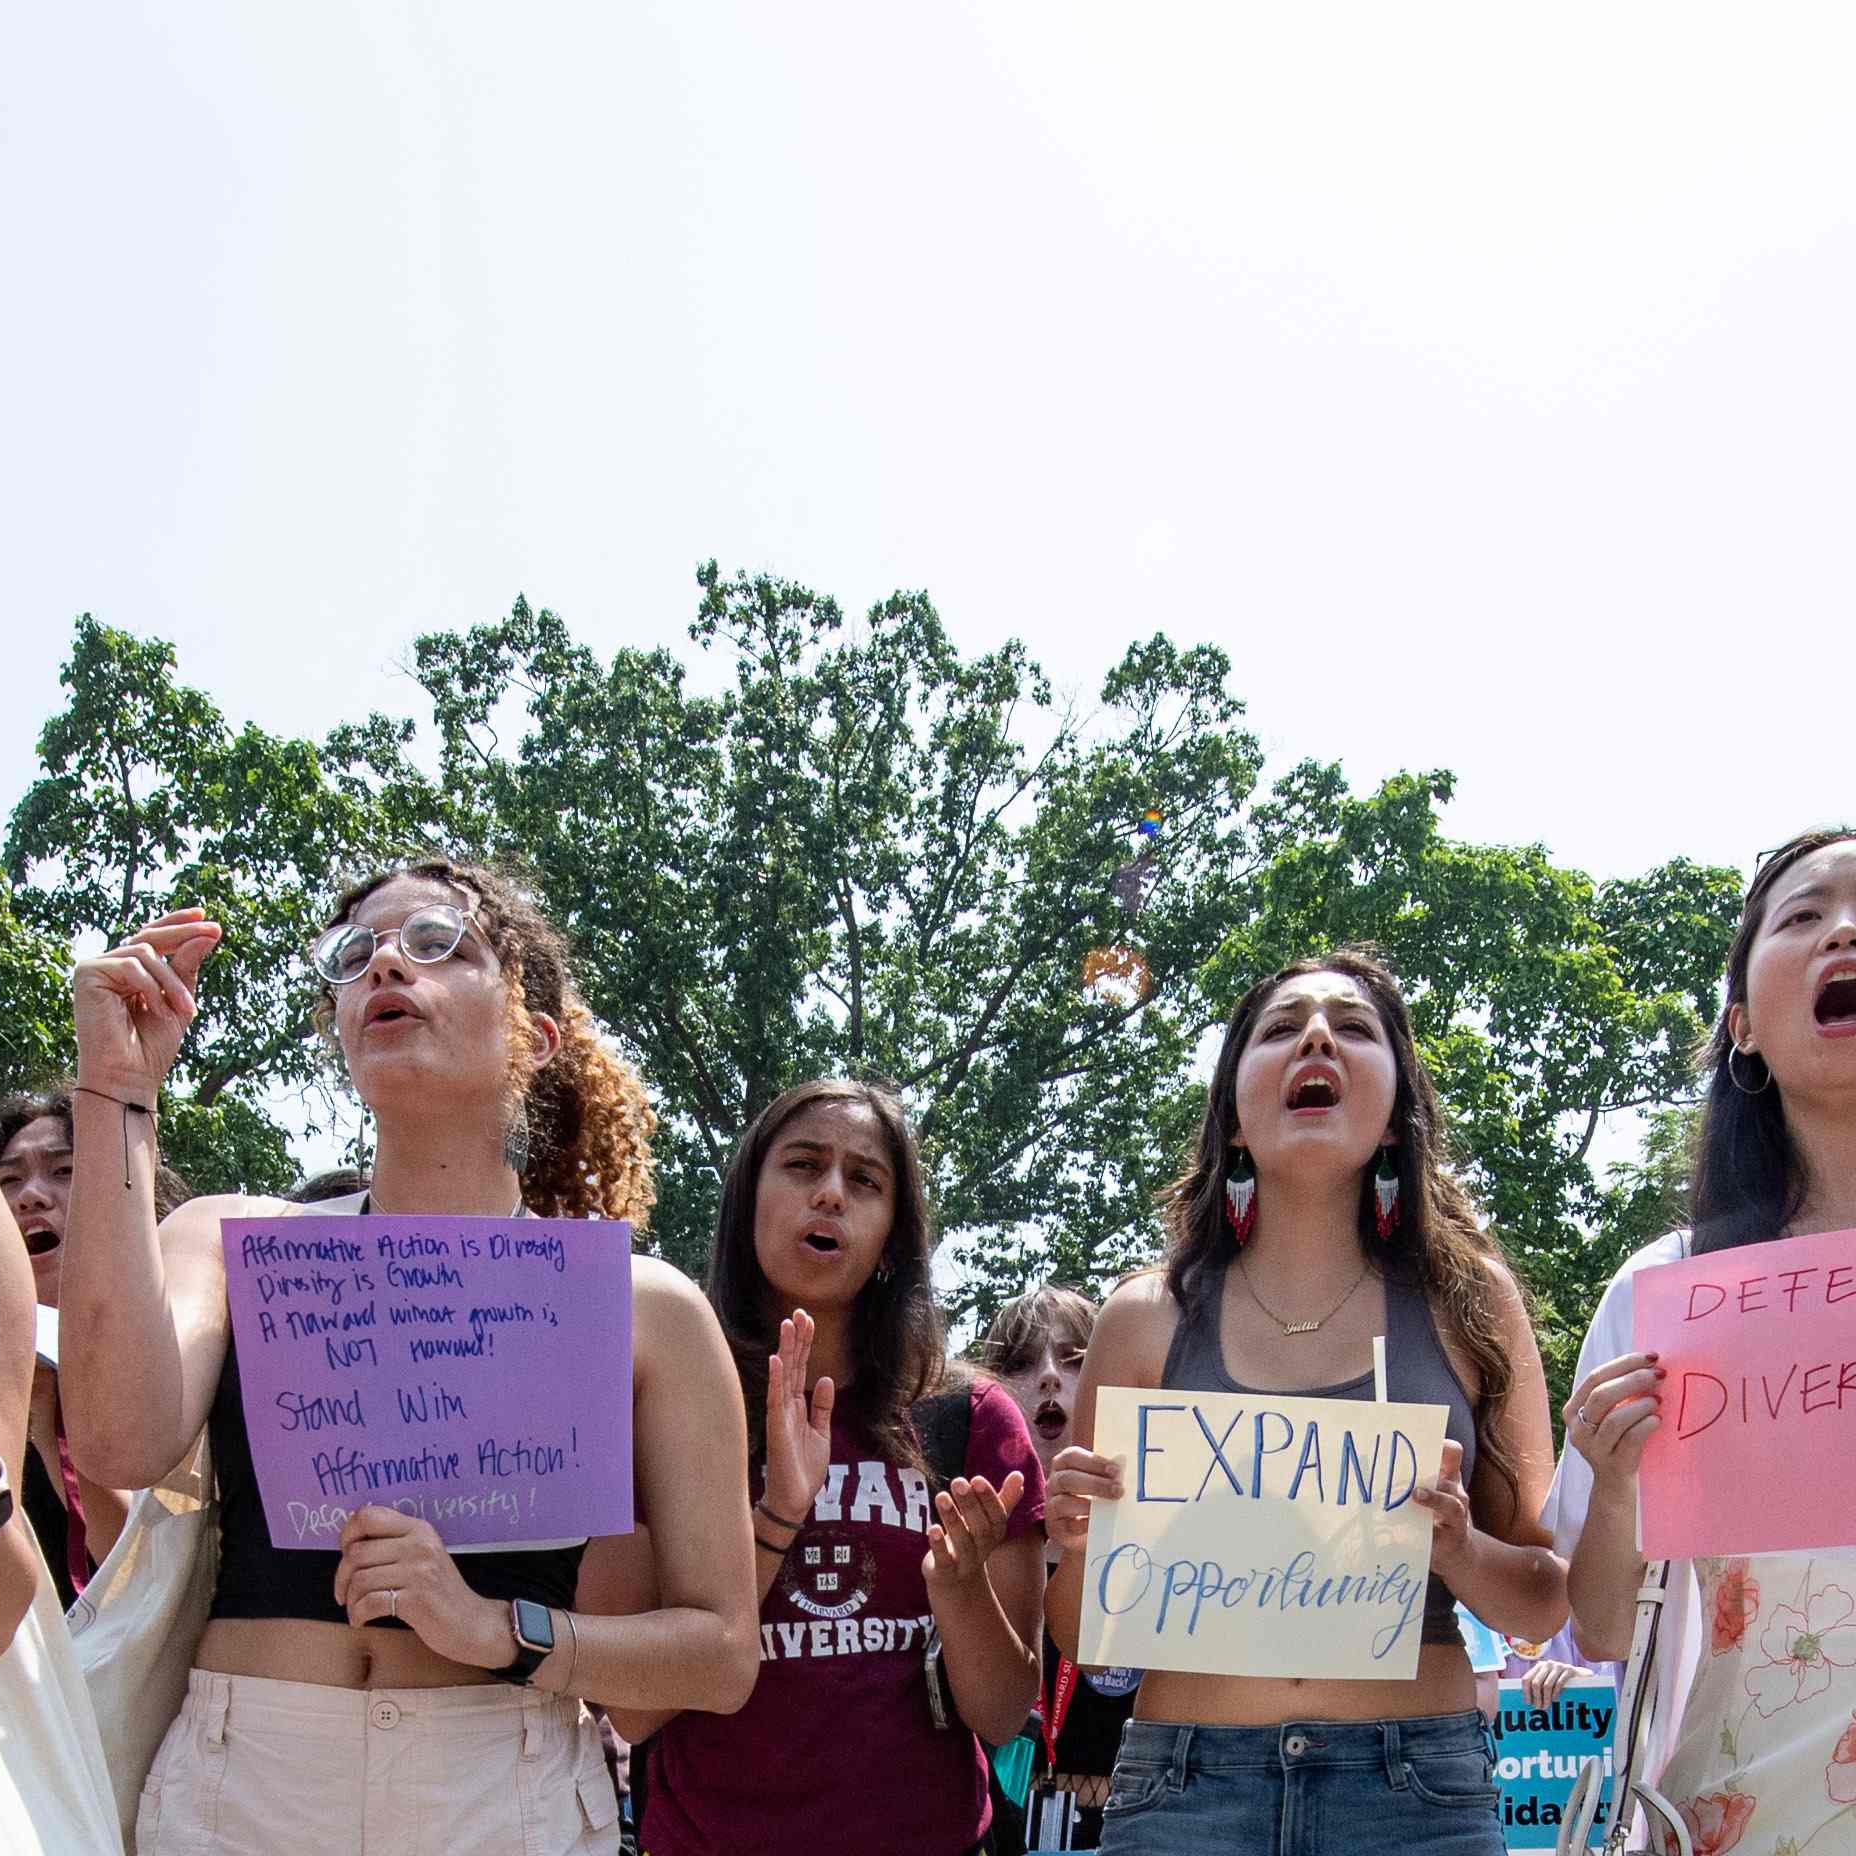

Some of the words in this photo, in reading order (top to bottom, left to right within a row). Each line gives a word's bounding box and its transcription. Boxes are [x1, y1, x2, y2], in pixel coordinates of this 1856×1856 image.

[376, 1233, 450, 1260] Action
[459, 1234, 481, 1258] is
[351, 1268, 376, 1292] is
[258, 1311, 278, 1344] A
[325, 1336, 378, 1371] NOT
[275, 1389, 367, 1432] Stand
[311, 1443, 460, 1498] Affirmative
[477, 1426, 581, 1479] Action!
[1136, 1405, 1418, 1512] EXPAND
[803, 1601, 855, 1618] HARVARD
[1090, 1543, 1424, 1660] Opportunity
[1494, 1701, 1613, 1740] quality
